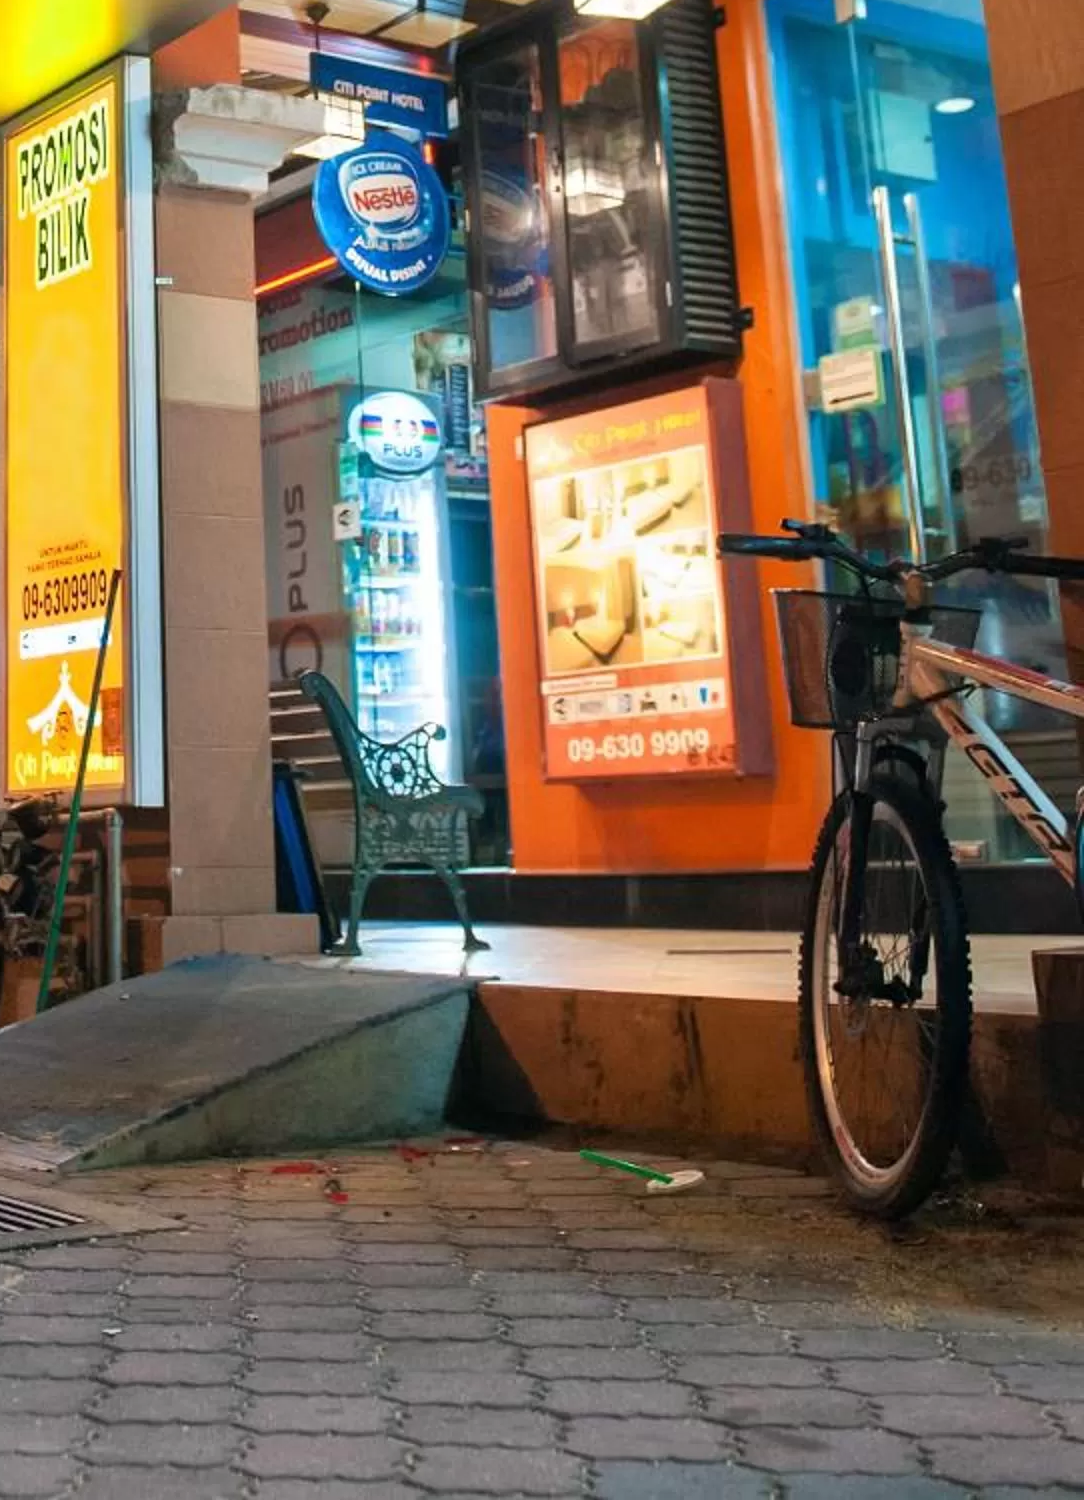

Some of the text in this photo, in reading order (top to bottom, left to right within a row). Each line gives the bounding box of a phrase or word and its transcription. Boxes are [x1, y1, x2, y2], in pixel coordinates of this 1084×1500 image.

[391, 93, 425, 112] HOTEL
[17, 102, 109, 216] PROMOSI
[37, 189, 92, 289] BILIK
[283, 483, 309, 613] PLUS
[568, 732, 645, 763] 09-630
